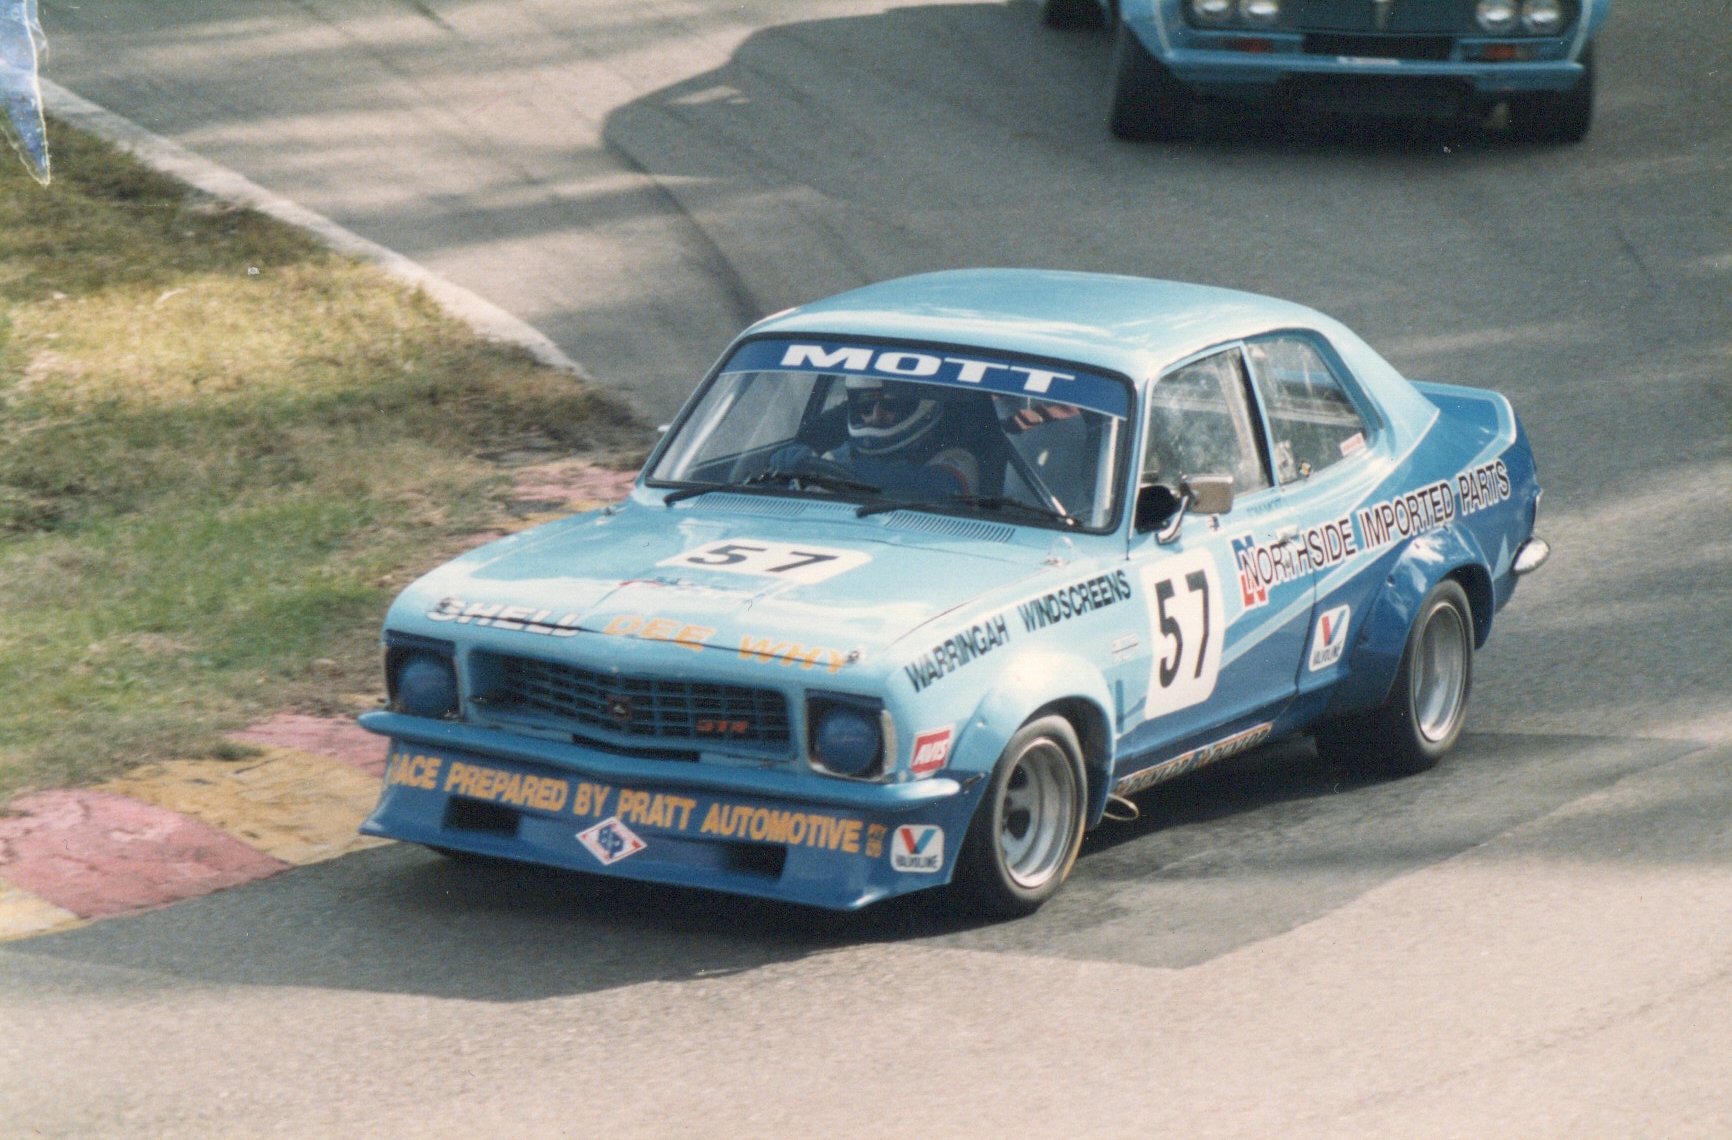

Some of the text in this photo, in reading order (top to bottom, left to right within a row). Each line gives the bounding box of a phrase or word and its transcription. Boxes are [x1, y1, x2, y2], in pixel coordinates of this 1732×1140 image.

[780, 344, 1075, 393] MOTT
[1359, 482, 1454, 549] IMPORTED
[1458, 460, 1511, 514] PARTS
[687, 544, 838, 573] 57
[426, 597, 581, 637] SHELL
[603, 614, 717, 652] DEE
[904, 569, 1132, 693] WARRINGAH WINDSCREENS
[1154, 568, 1210, 688] 57
[443, 761, 568, 813] PREPARED
[573, 781, 610, 817] BY
[615, 788, 696, 831] PRATT
[700, 803, 863, 854] AUTOMOTIVE
